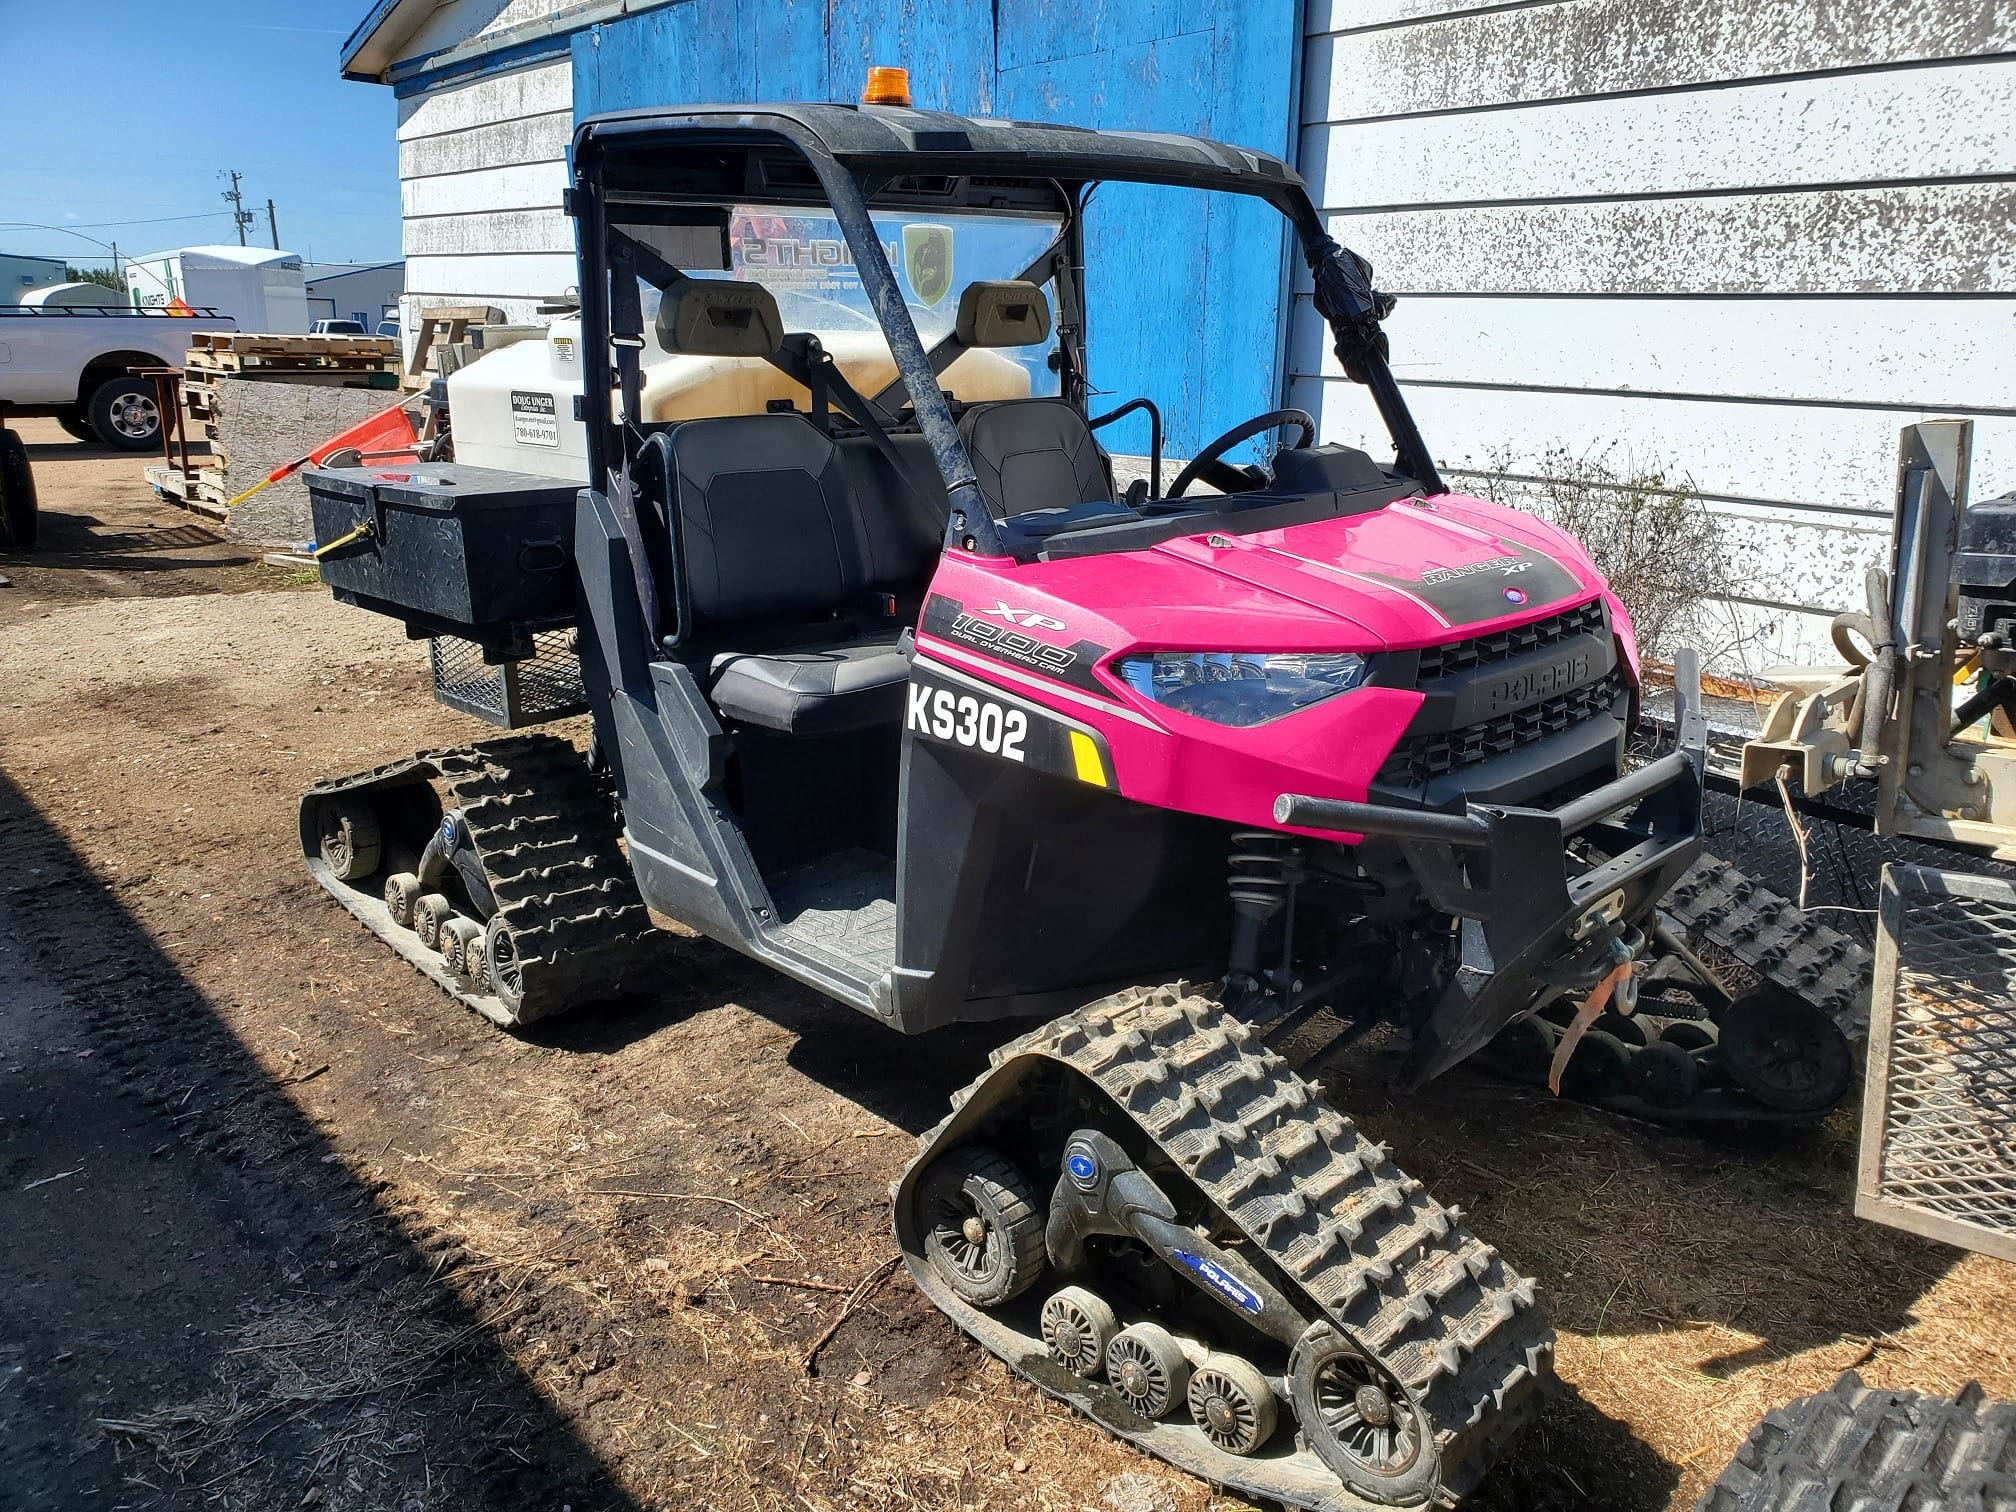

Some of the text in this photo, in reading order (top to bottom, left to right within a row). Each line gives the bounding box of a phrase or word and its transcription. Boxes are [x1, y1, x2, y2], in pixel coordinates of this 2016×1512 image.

[142, 293, 166, 306] KNIGHTS
[990, 291, 1038, 301] RANGER
[512, 395, 554, 408] DOUG UNGER
[516, 427, 556, 441] 780-618-9701
[1421, 556, 1520, 586] RANGER
[1500, 562, 1534, 577] XP
[973, 599, 1068, 632] XP
[950, 629, 1066, 676] DUAL OVERHEAD CAM
[951, 612, 1078, 669] 1000
[1491, 653, 1589, 711] POLARIS
[907, 682, 1028, 763] KS302
[1199, 1263, 1249, 1303] POLARIS
